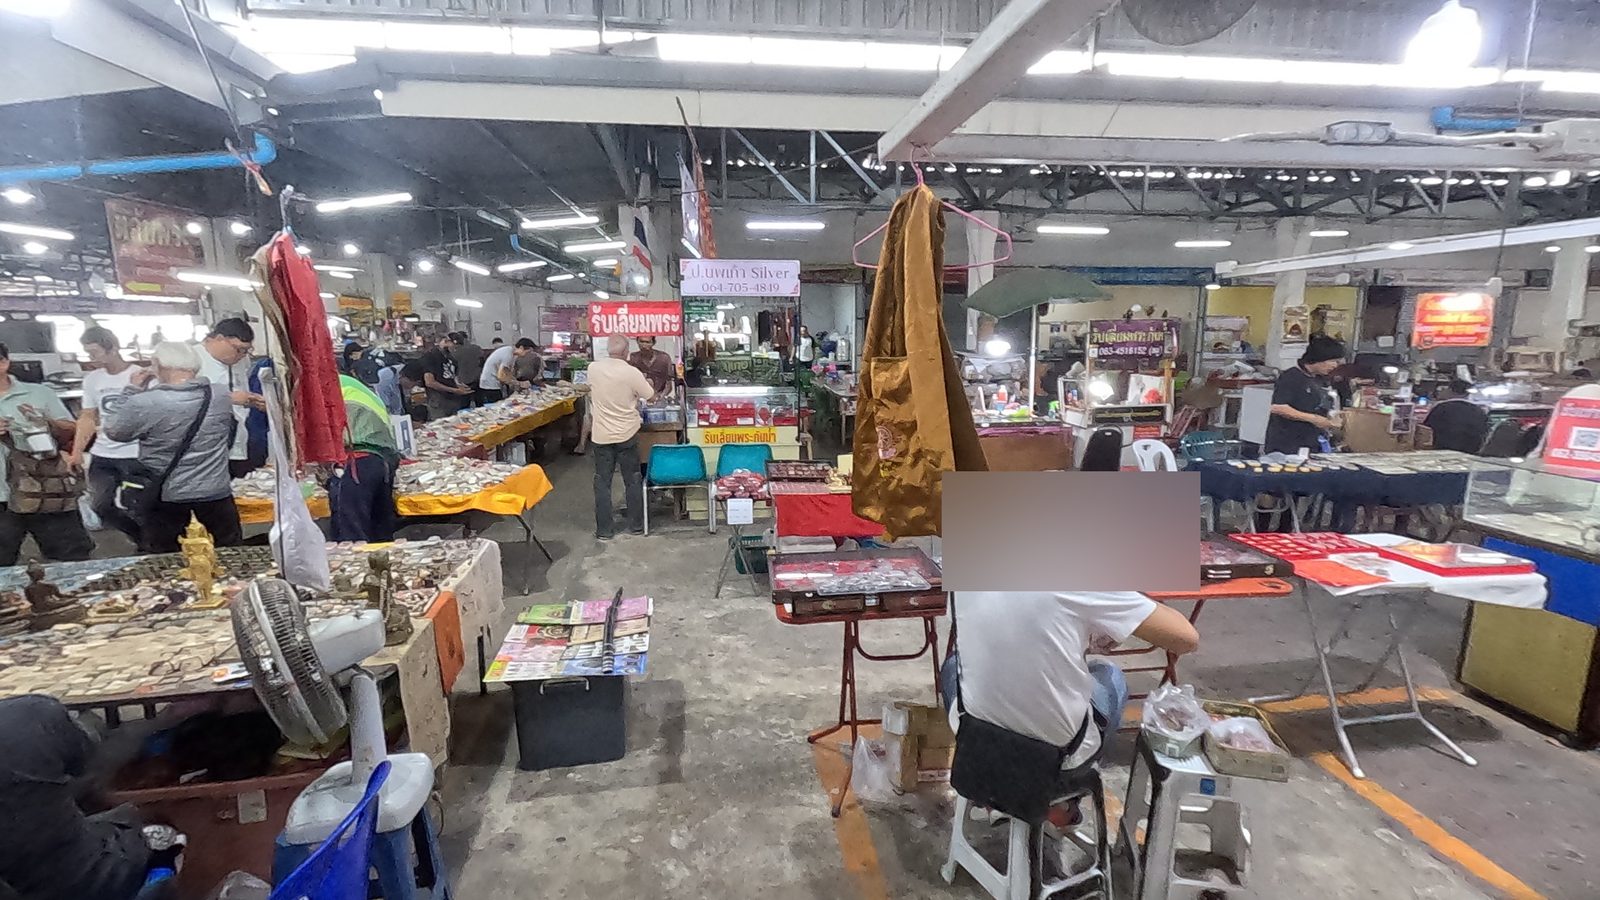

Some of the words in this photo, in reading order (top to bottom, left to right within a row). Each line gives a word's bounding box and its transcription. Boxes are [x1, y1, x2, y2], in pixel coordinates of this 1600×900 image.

[751, 266, 790, 279] Silver
[702, 283, 780, 293] 064-705-4849
[591, 303, 680, 334] รับเลี่ยมพระ
